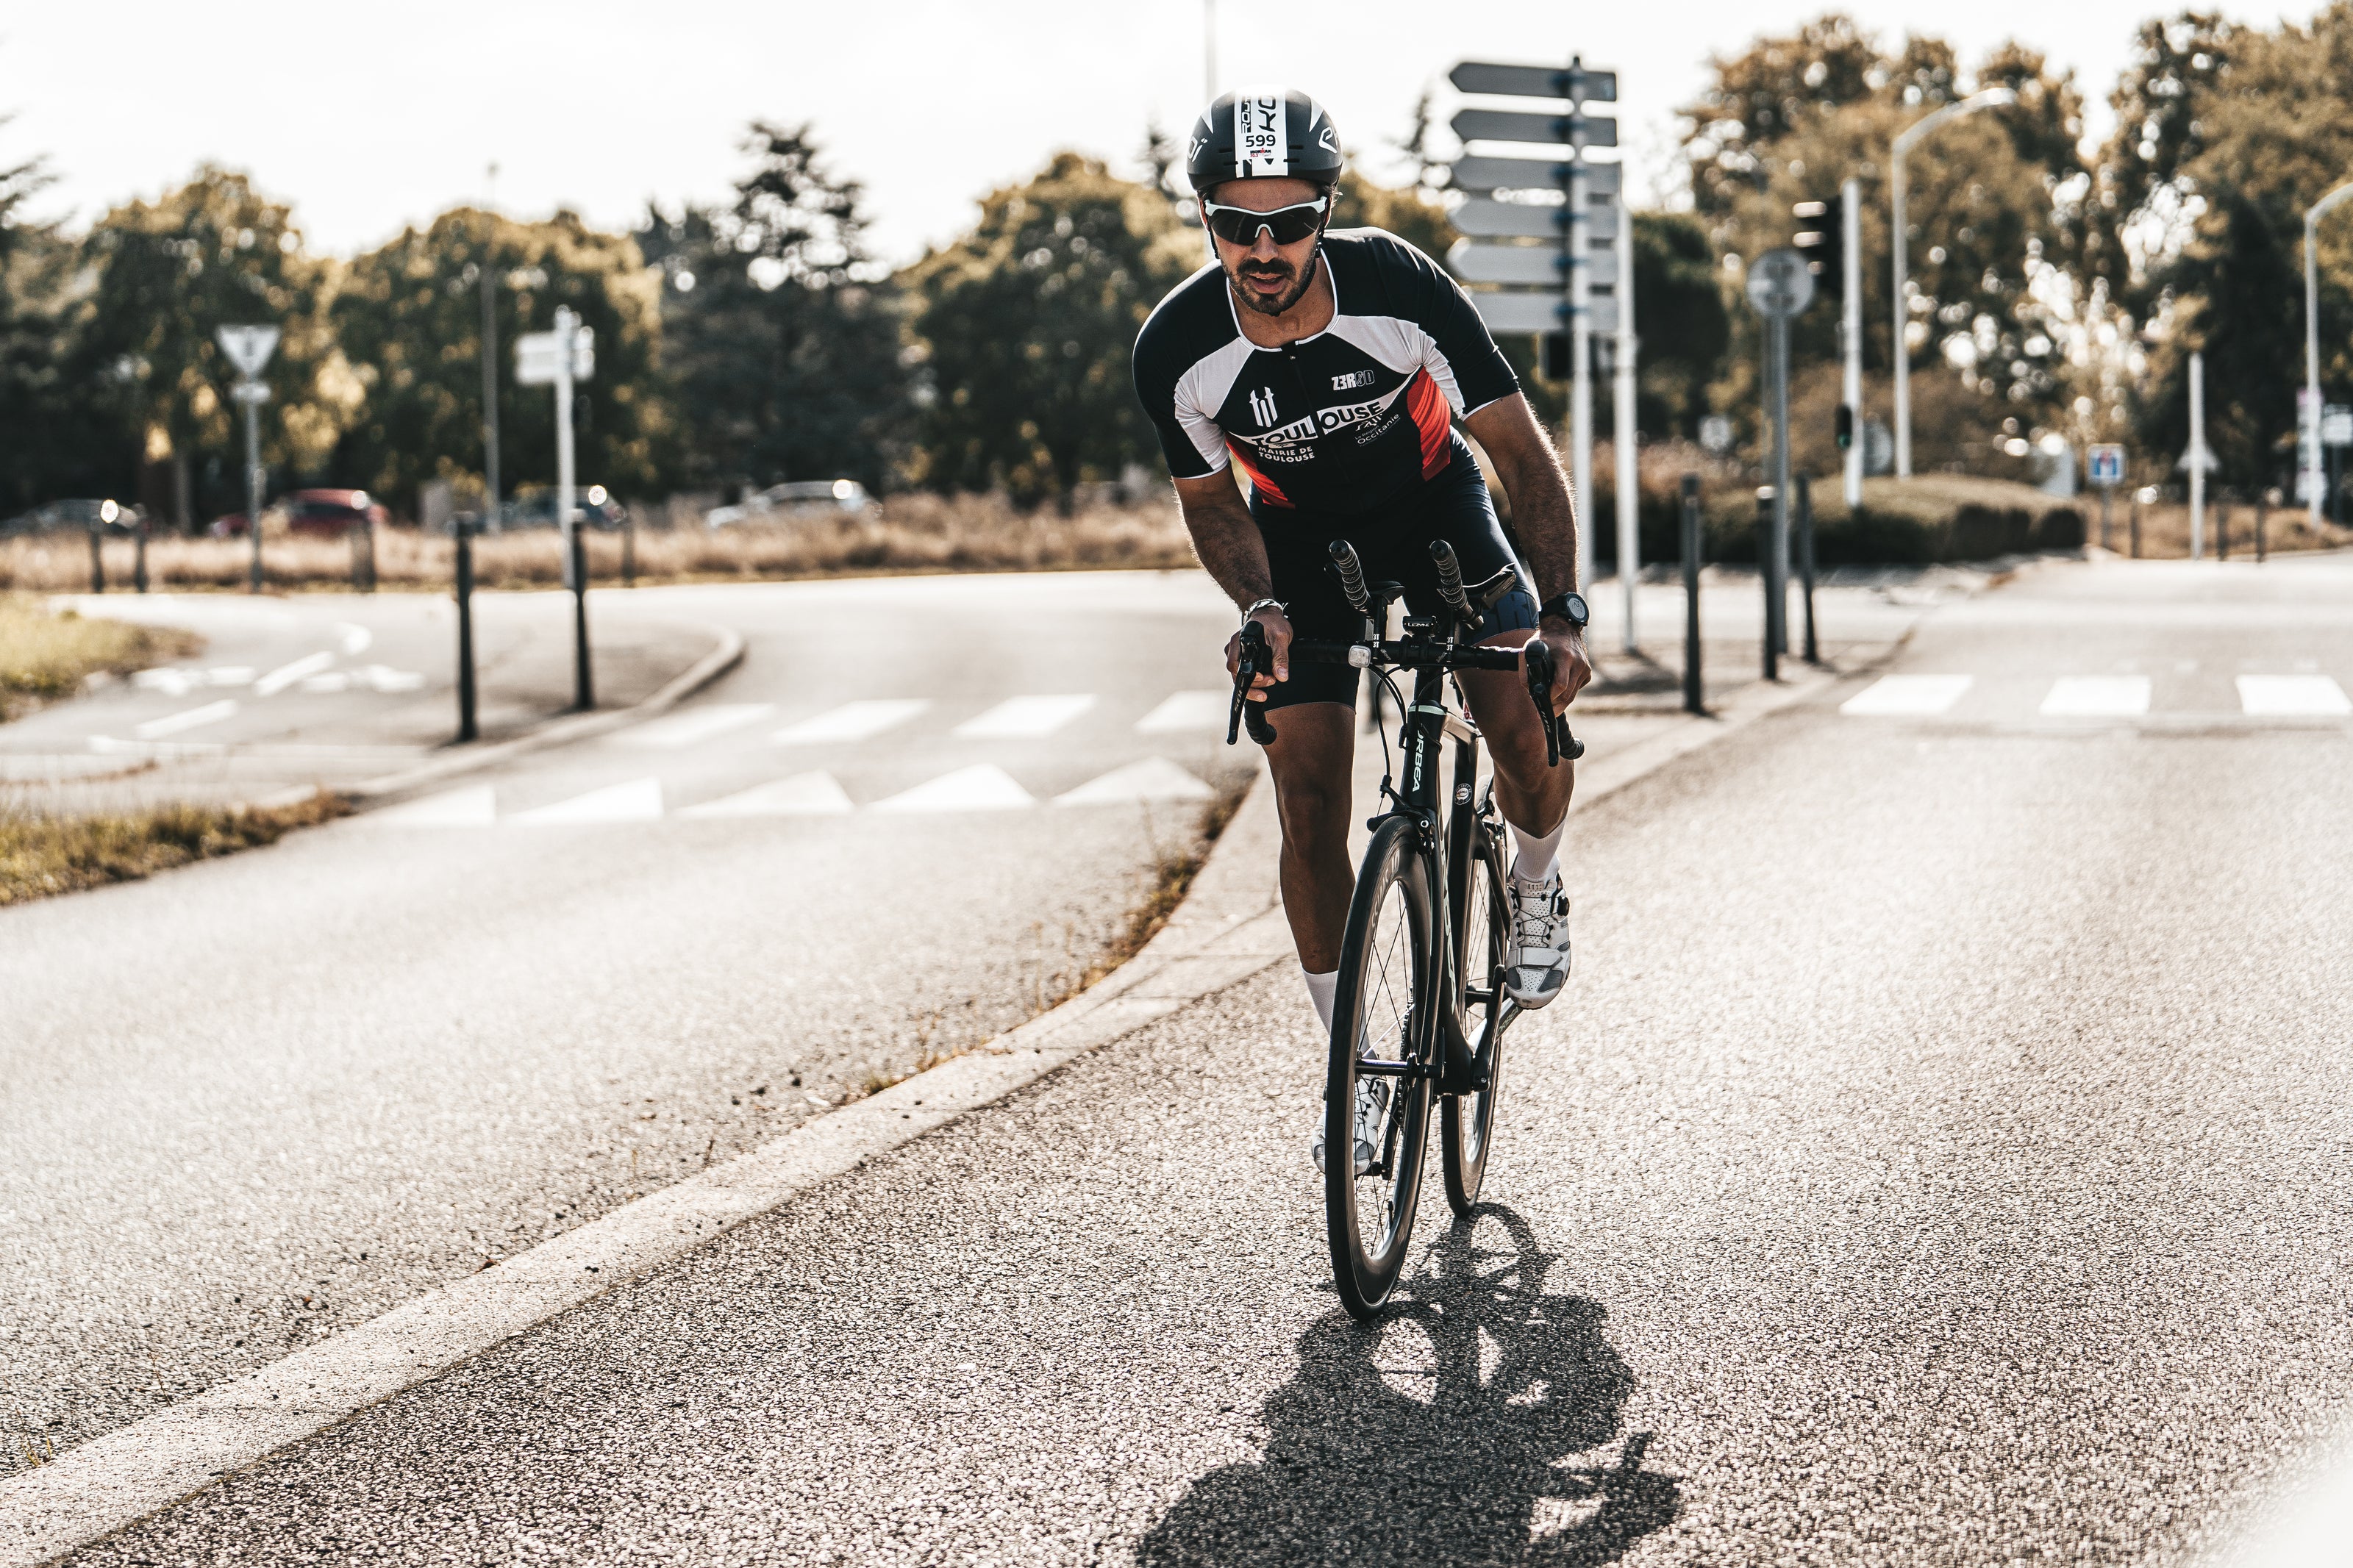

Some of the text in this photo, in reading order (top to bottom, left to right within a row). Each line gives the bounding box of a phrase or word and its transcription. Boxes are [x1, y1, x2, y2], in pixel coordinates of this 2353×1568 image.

[1246, 135, 1276, 147] 599
[1357, 414, 1399, 444] Occitanie
[1259, 446, 1296, 456] MAIRIE
[1259, 452, 1315, 462] TOULOUSE
